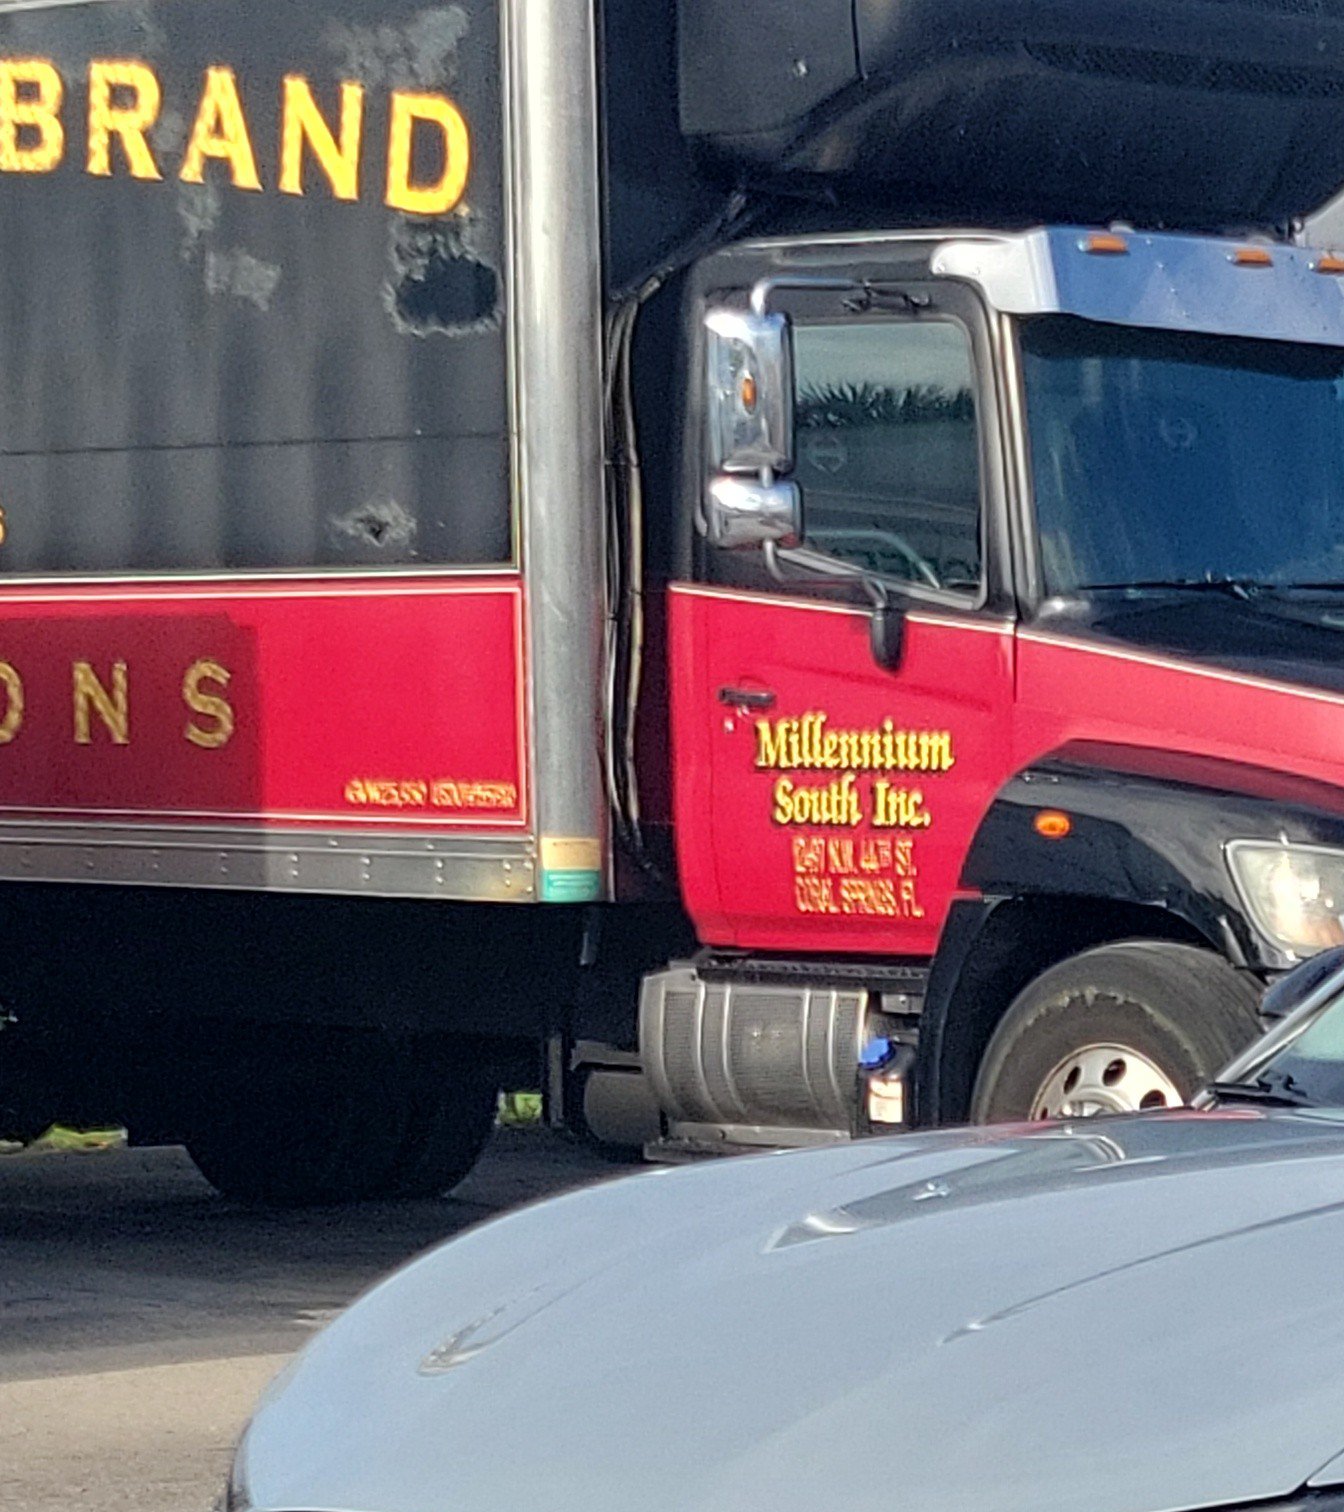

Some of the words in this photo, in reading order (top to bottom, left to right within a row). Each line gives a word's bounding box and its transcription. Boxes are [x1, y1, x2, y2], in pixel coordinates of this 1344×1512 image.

[0, 57, 471, 216] BRAND
[755, 710, 956, 771] Millennium
[773, 772, 863, 826] South
[871, 779, 932, 828] Inc.
